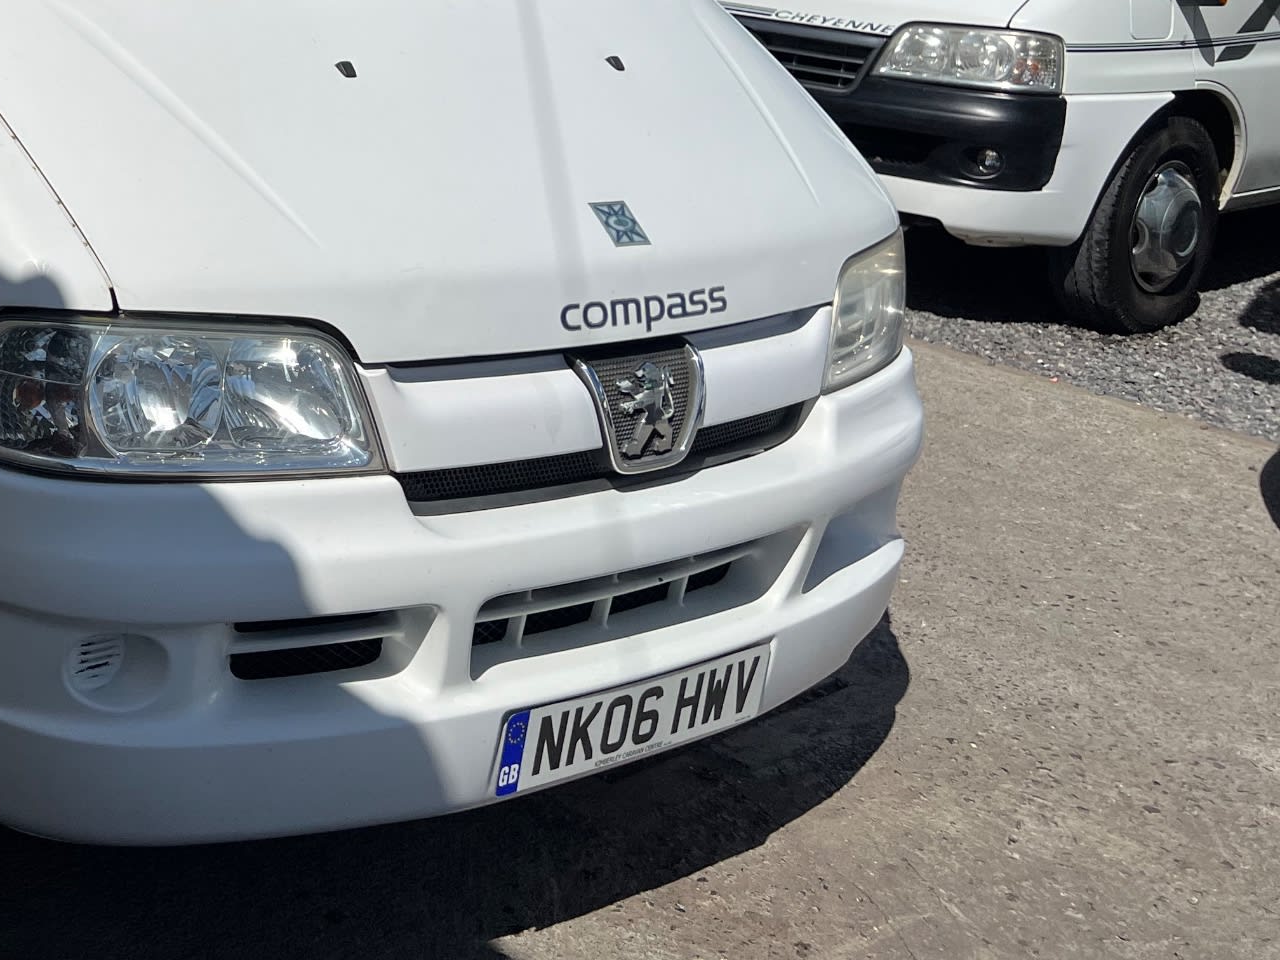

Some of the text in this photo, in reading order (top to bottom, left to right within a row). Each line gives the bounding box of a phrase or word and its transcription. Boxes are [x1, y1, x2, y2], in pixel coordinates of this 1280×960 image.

[774, 9, 897, 34] CHEYENNE
[560, 285, 728, 333] compass
[531, 655, 761, 777] NK06 HWV
[498, 762, 520, 788] GB
